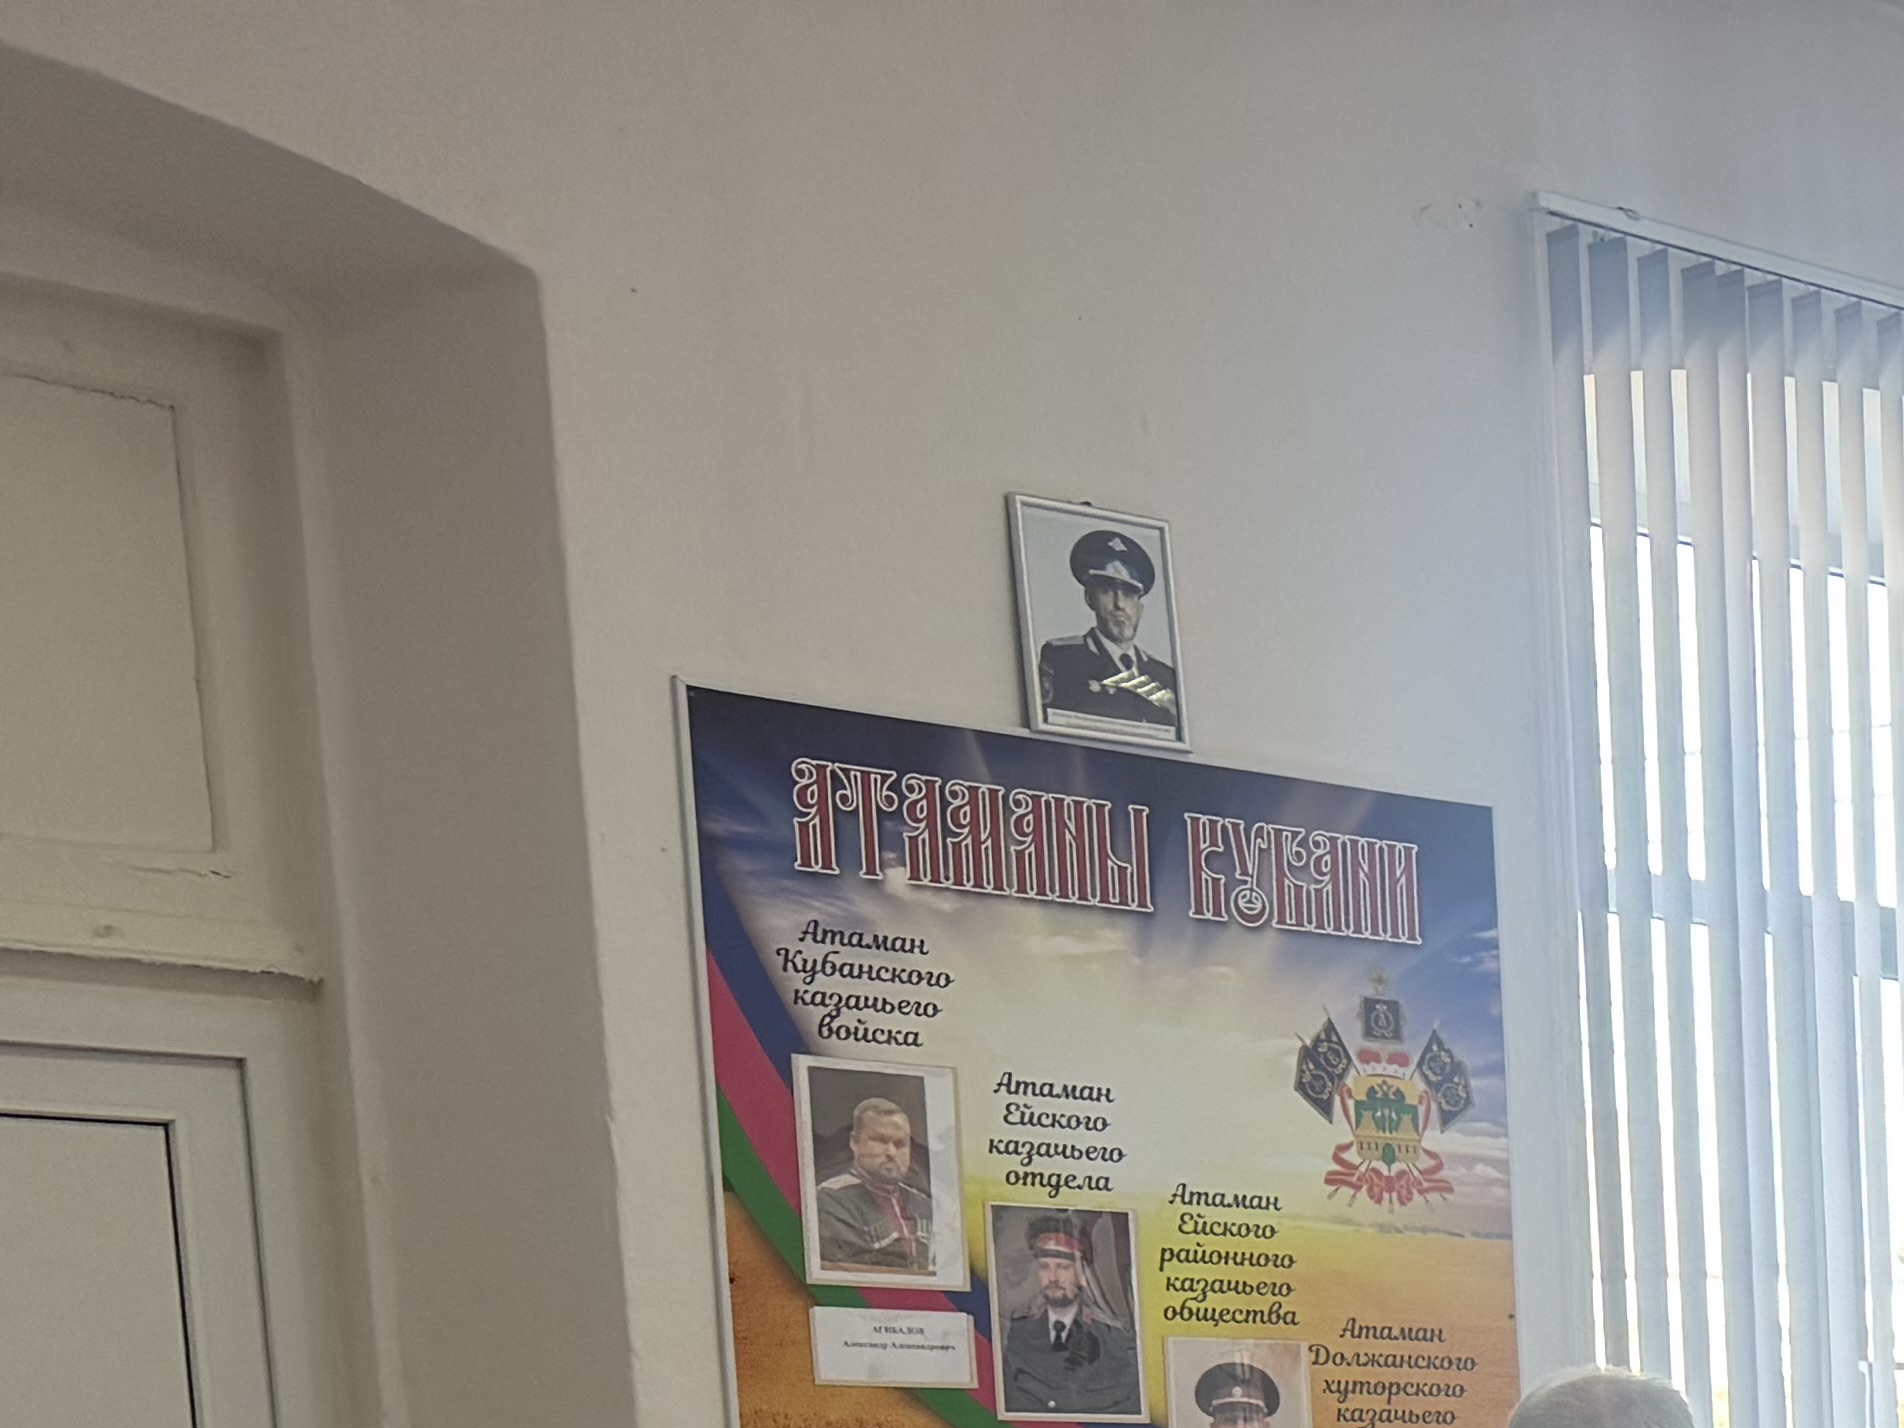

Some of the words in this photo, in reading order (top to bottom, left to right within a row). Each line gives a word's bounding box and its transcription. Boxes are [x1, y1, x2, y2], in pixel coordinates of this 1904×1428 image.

[792, 757, 1154, 912] АТАМАНЫ
[1185, 812, 1422, 944] КУБАНИ
[798, 919, 929, 955] Атаман
[776, 947, 955, 988] Кубанского
[793, 988, 943, 1020] казачьего
[818, 1013, 923, 1047] войска
[993, 1071, 1115, 1103] Атаман
[1002, 1102, 1111, 1132] Ейского
[987, 1138, 1127, 1167] казачьего
[1005, 1170, 1114, 1198] отдела
[1168, 1182, 1282, 1212] Атаман
[1178, 1212, 1279, 1240] Ейского
[1158, 1242, 1297, 1273] районного
[1165, 1274, 1296, 1303] казачьего
[1163, 1298, 1300, 1327] общества
[1340, 1316, 1446, 1343] Атаман
[1308, 1344, 1479, 1372] Должанского
[1322, 1377, 1468, 1405] хуторского
